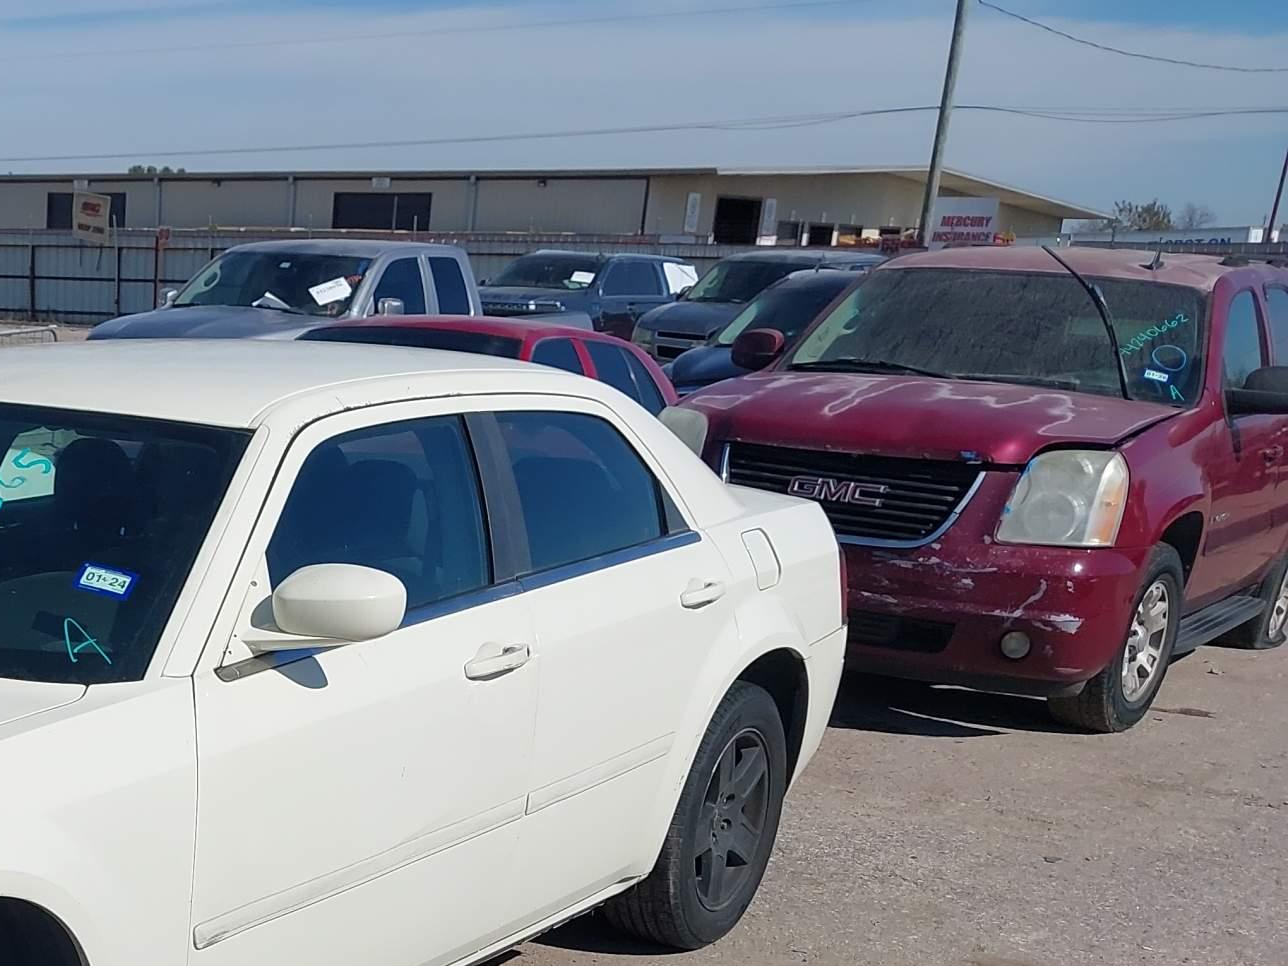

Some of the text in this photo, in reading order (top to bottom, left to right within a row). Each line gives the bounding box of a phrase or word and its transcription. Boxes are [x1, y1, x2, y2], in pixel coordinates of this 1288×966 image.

[941, 215, 992, 228] MERCURY
[1169, 384, 1185, 401] A
[787, 476, 889, 507] GMC
[63, 617, 113, 665] A
